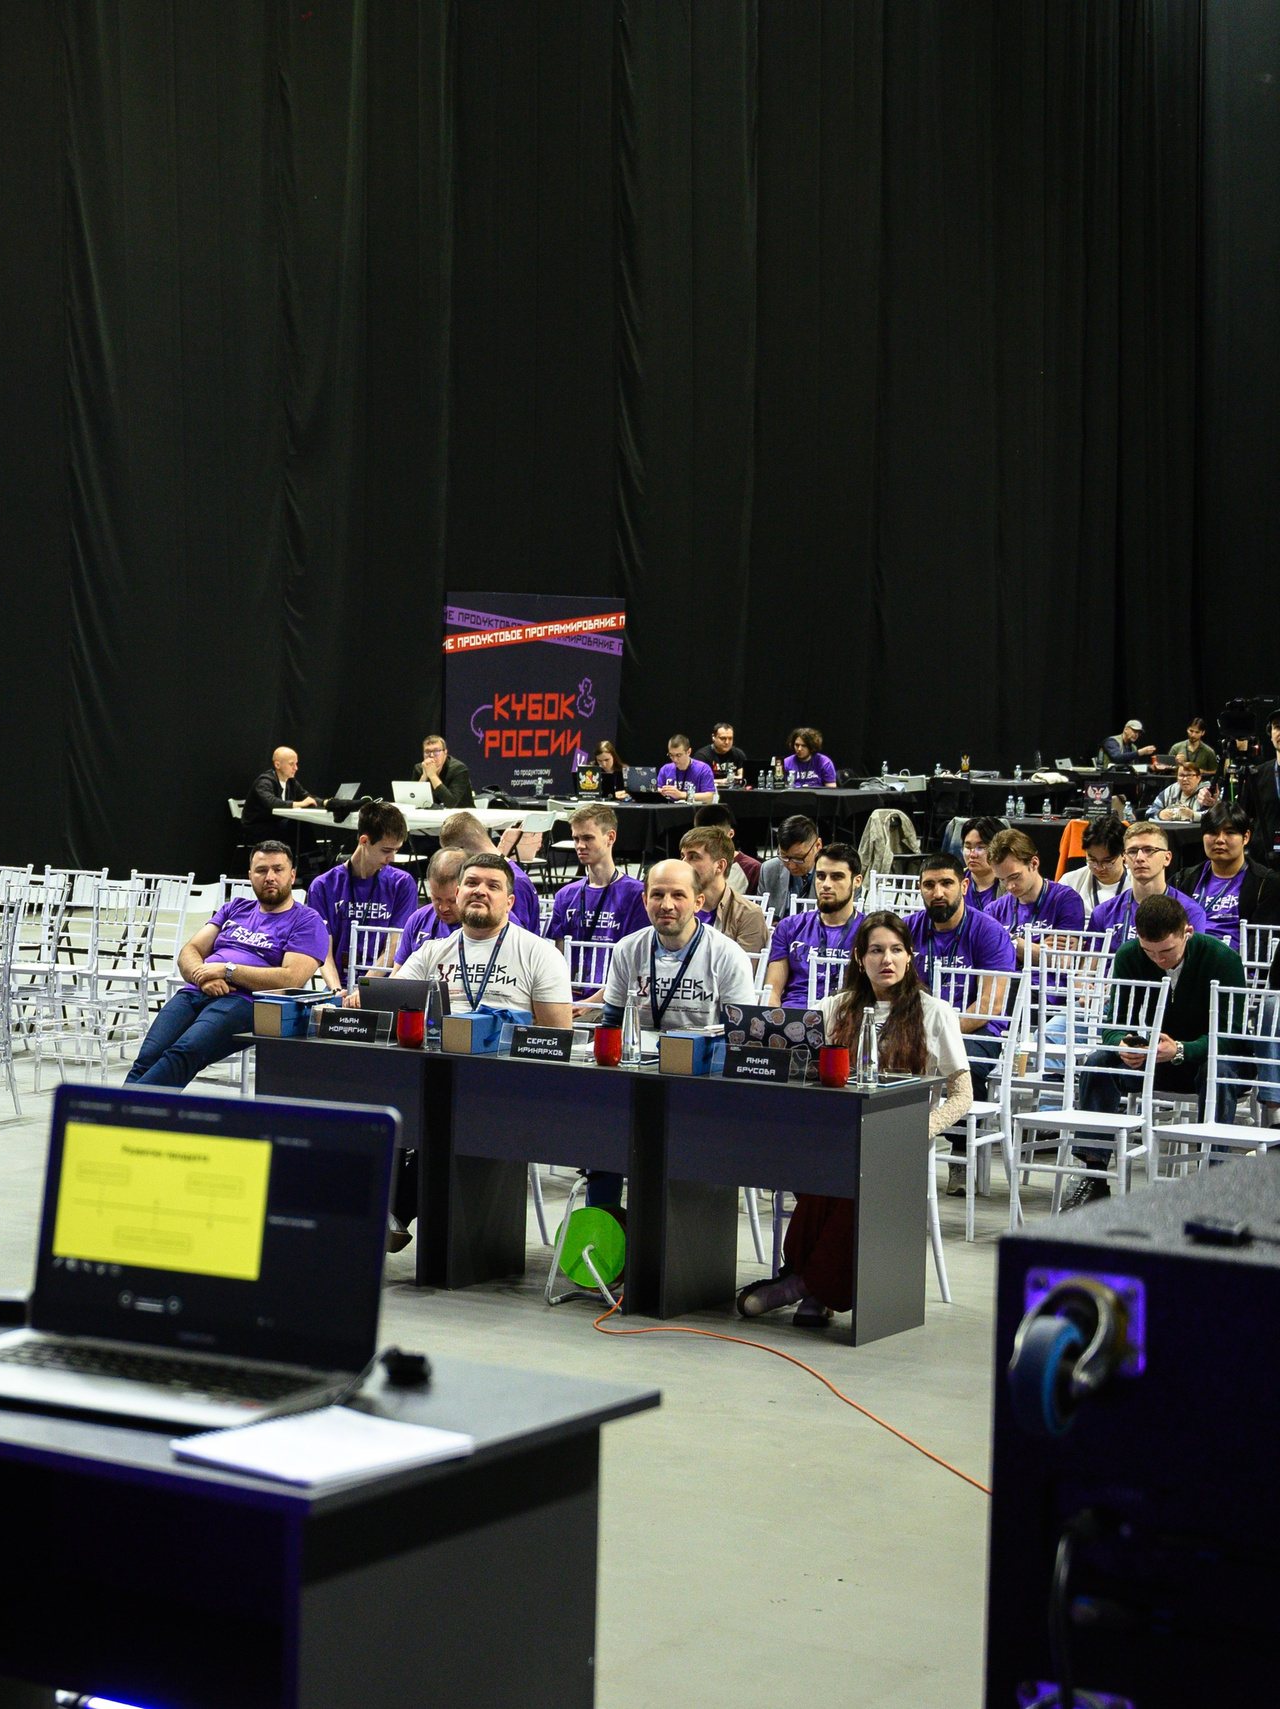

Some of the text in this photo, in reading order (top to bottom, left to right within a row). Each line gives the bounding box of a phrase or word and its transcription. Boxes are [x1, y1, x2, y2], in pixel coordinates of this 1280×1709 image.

[457, 629, 523, 649] ПРОДУКТОВОЕ
[524, 616, 617, 639] ПРОГРАММИРОВАНИЕ
[494, 693, 575, 721] КУБОК
[484, 730, 582, 758] РОССИИ
[339, 1016, 360, 1025] ИВАН
[526, 1037, 558, 1047] СЕРГЕЙ
[517, 1045, 564, 1057] ИРИНАРХОВ
[745, 1056, 770, 1066] АННА
[736, 1065, 776, 1077] БРУСОВА
